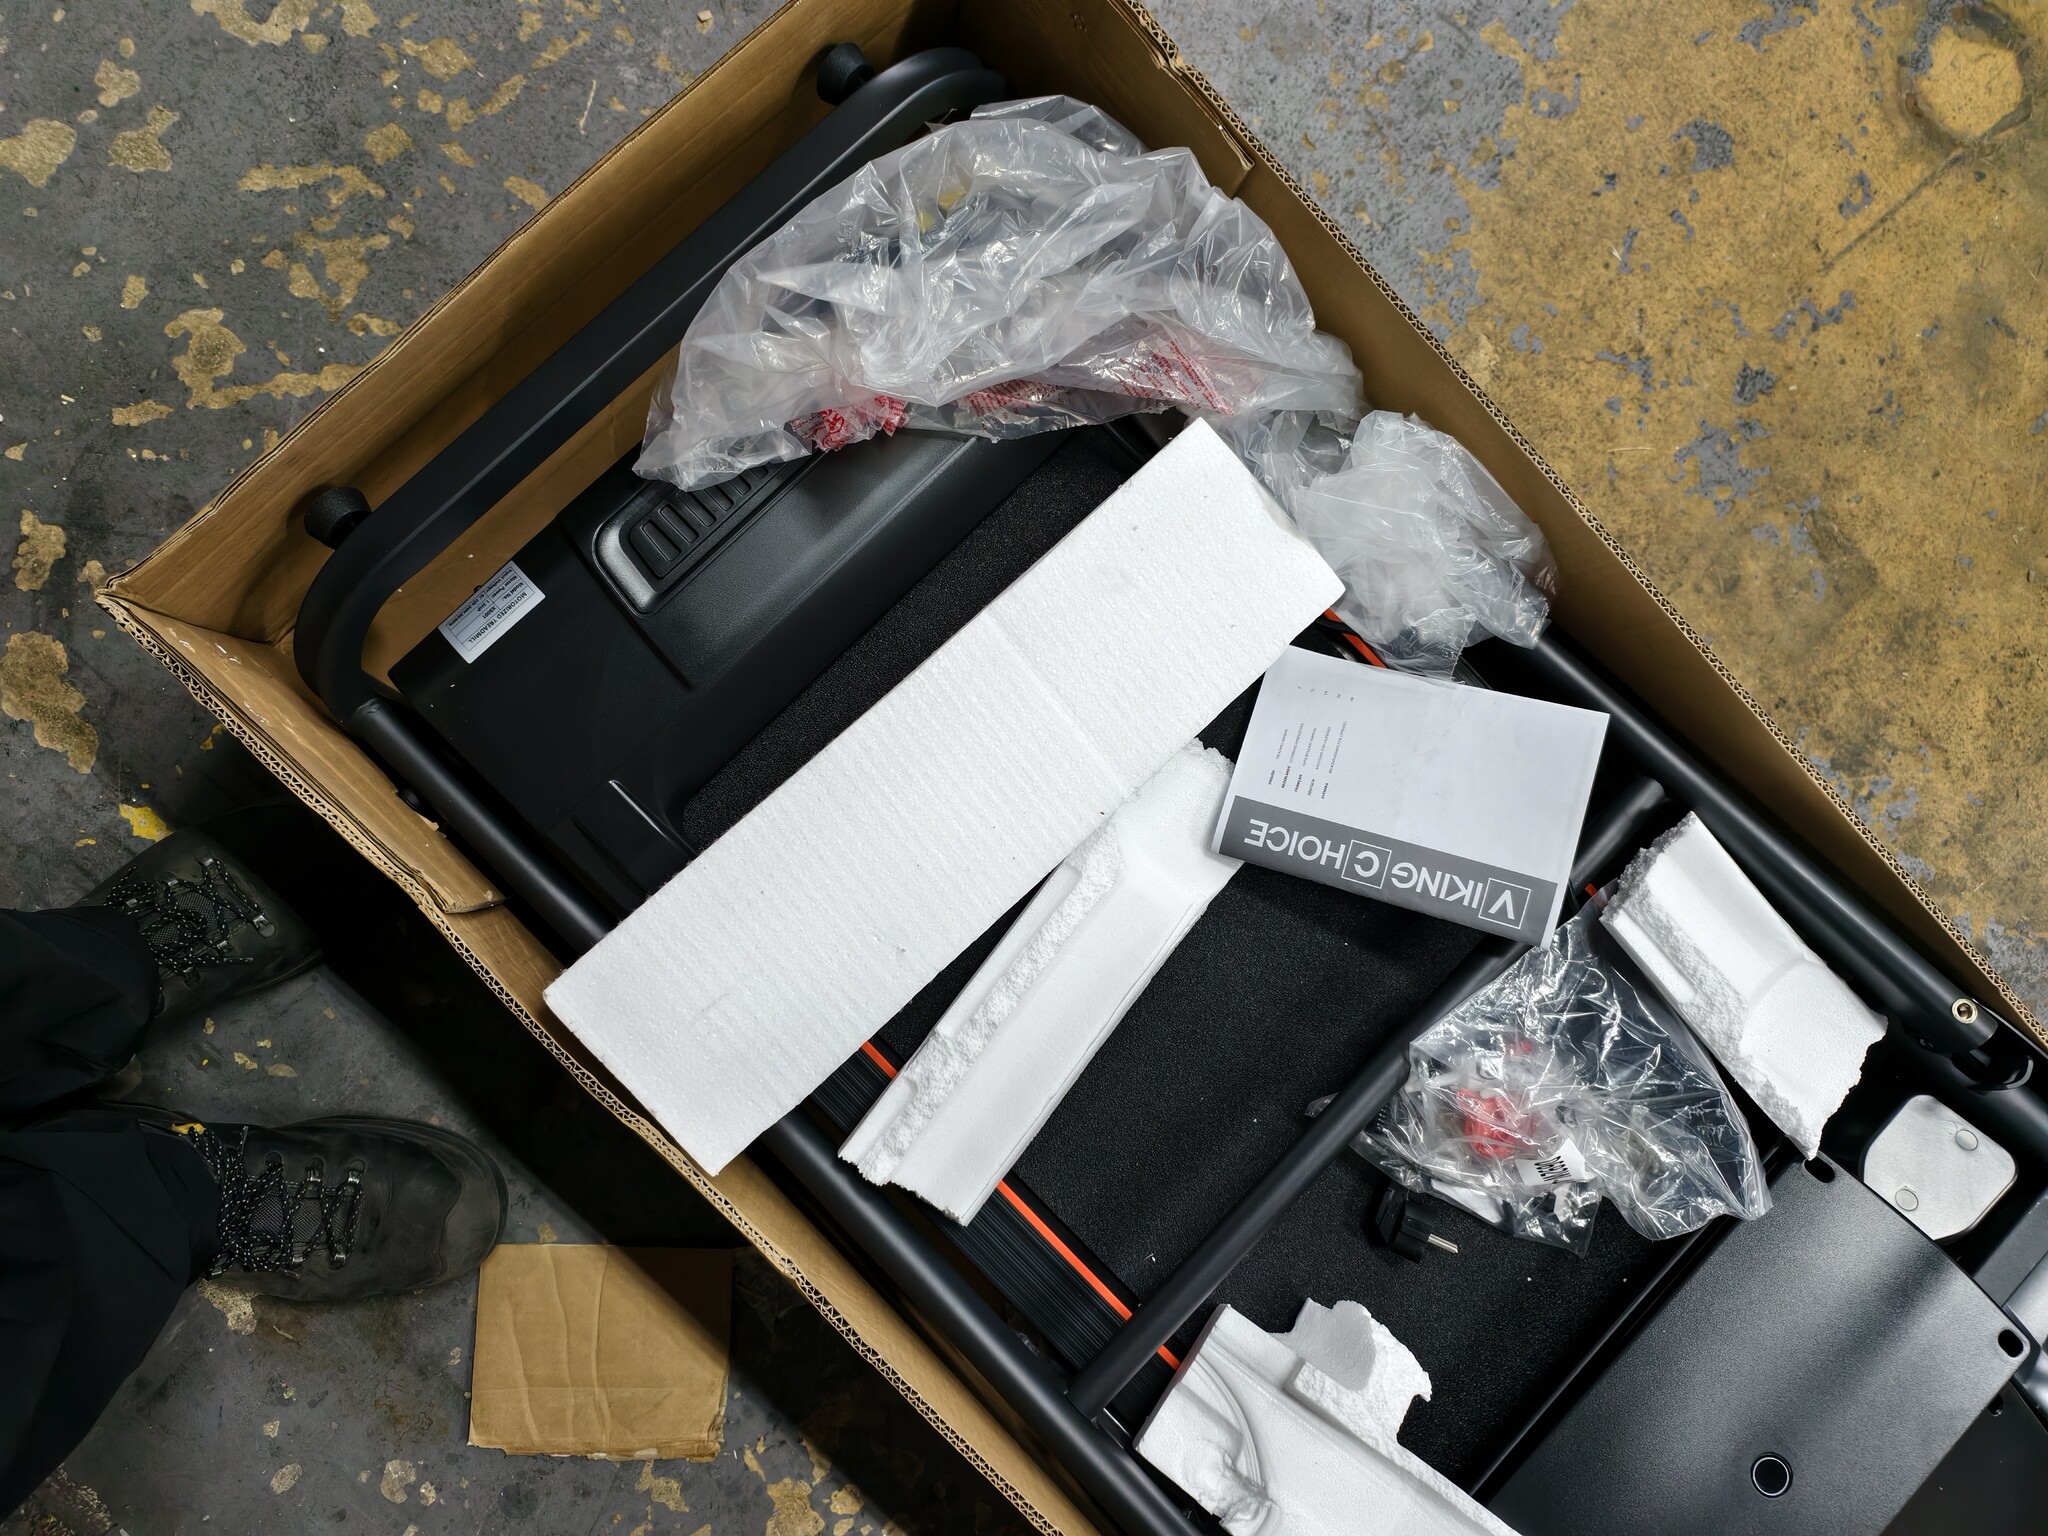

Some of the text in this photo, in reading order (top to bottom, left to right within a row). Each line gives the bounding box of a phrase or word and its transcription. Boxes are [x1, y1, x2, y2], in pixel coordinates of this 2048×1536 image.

[504, 574, 517, 587] Motor
[510, 581, 524, 594] Model
[468, 591, 526, 643] MOTORIZED TREADMILL
[1244, 818, 1516, 919] VIKING CHOICE
